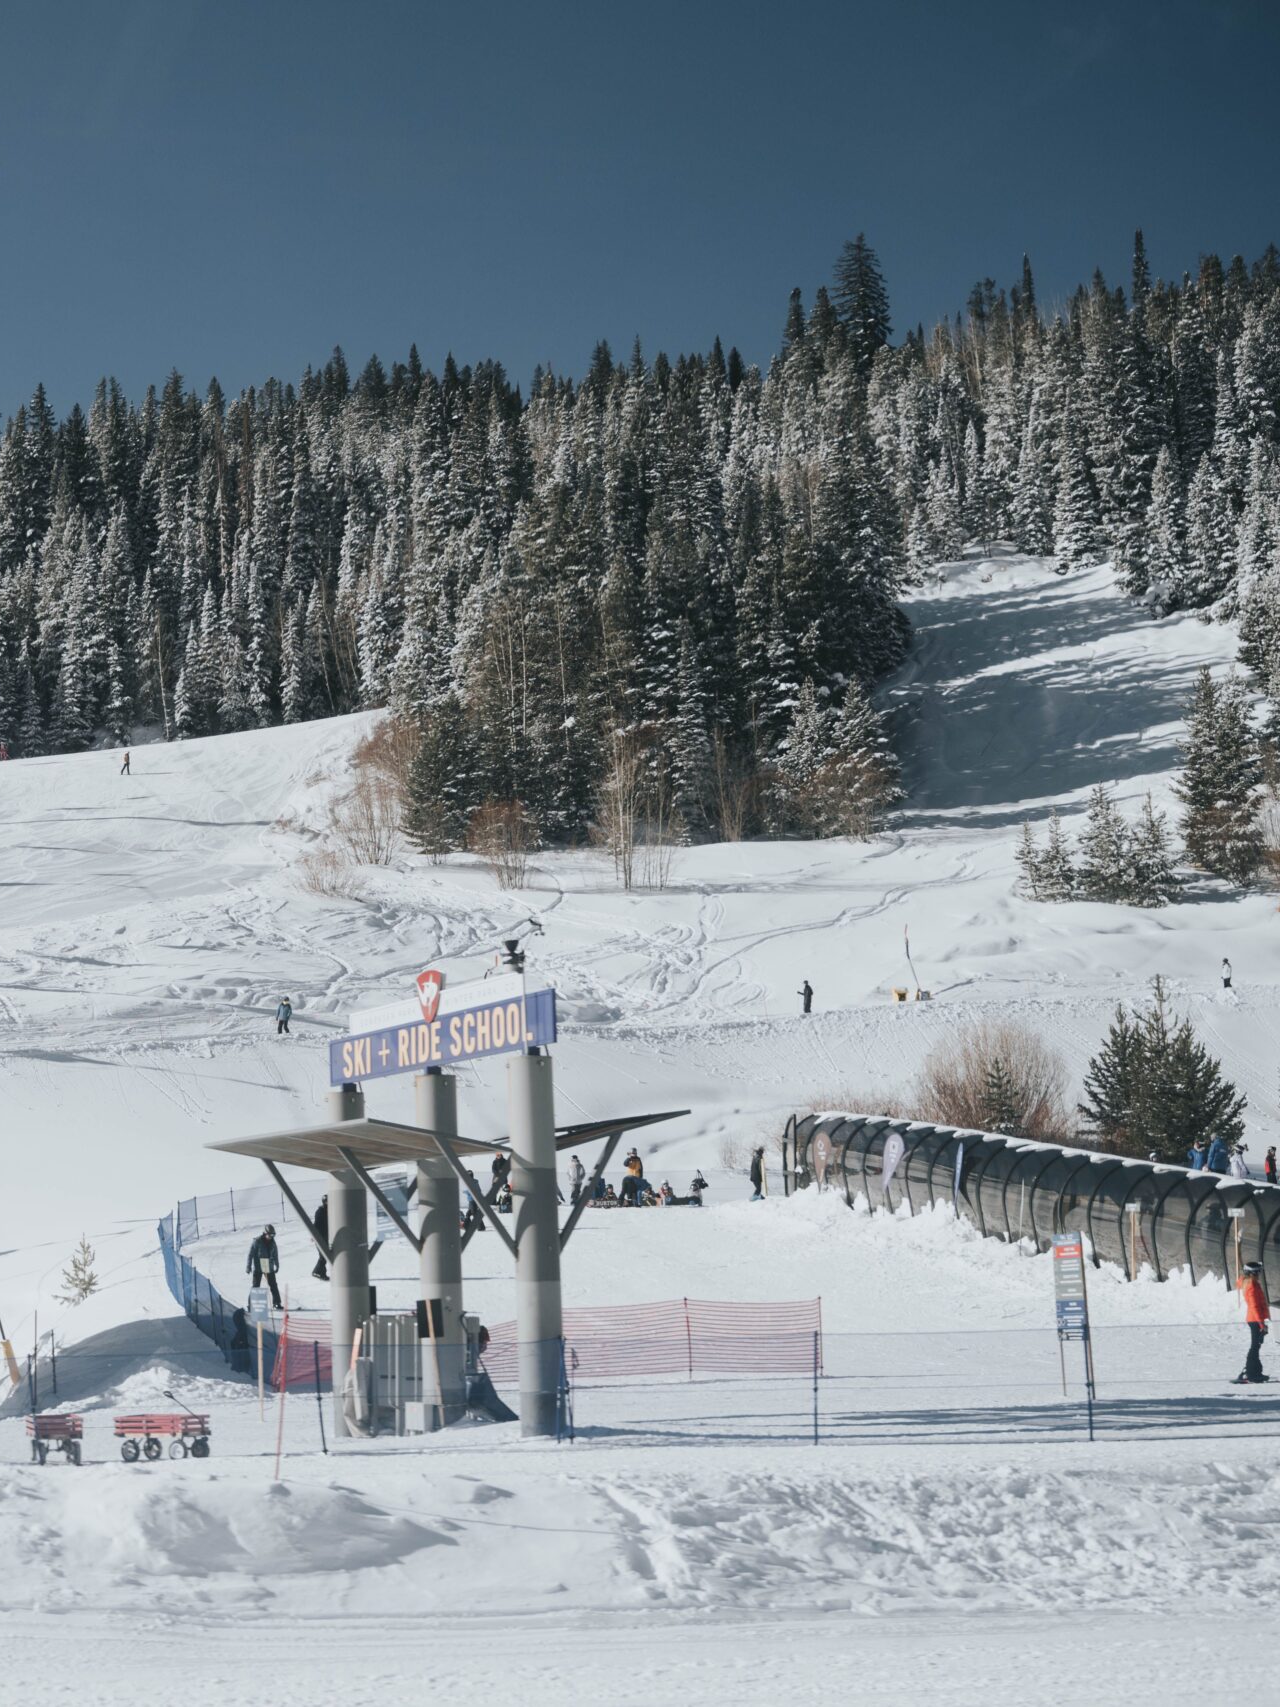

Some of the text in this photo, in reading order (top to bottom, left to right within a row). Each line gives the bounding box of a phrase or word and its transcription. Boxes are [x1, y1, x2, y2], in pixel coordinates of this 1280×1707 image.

[343, 1002, 533, 1079] SKI + RIDE SCHOOL
